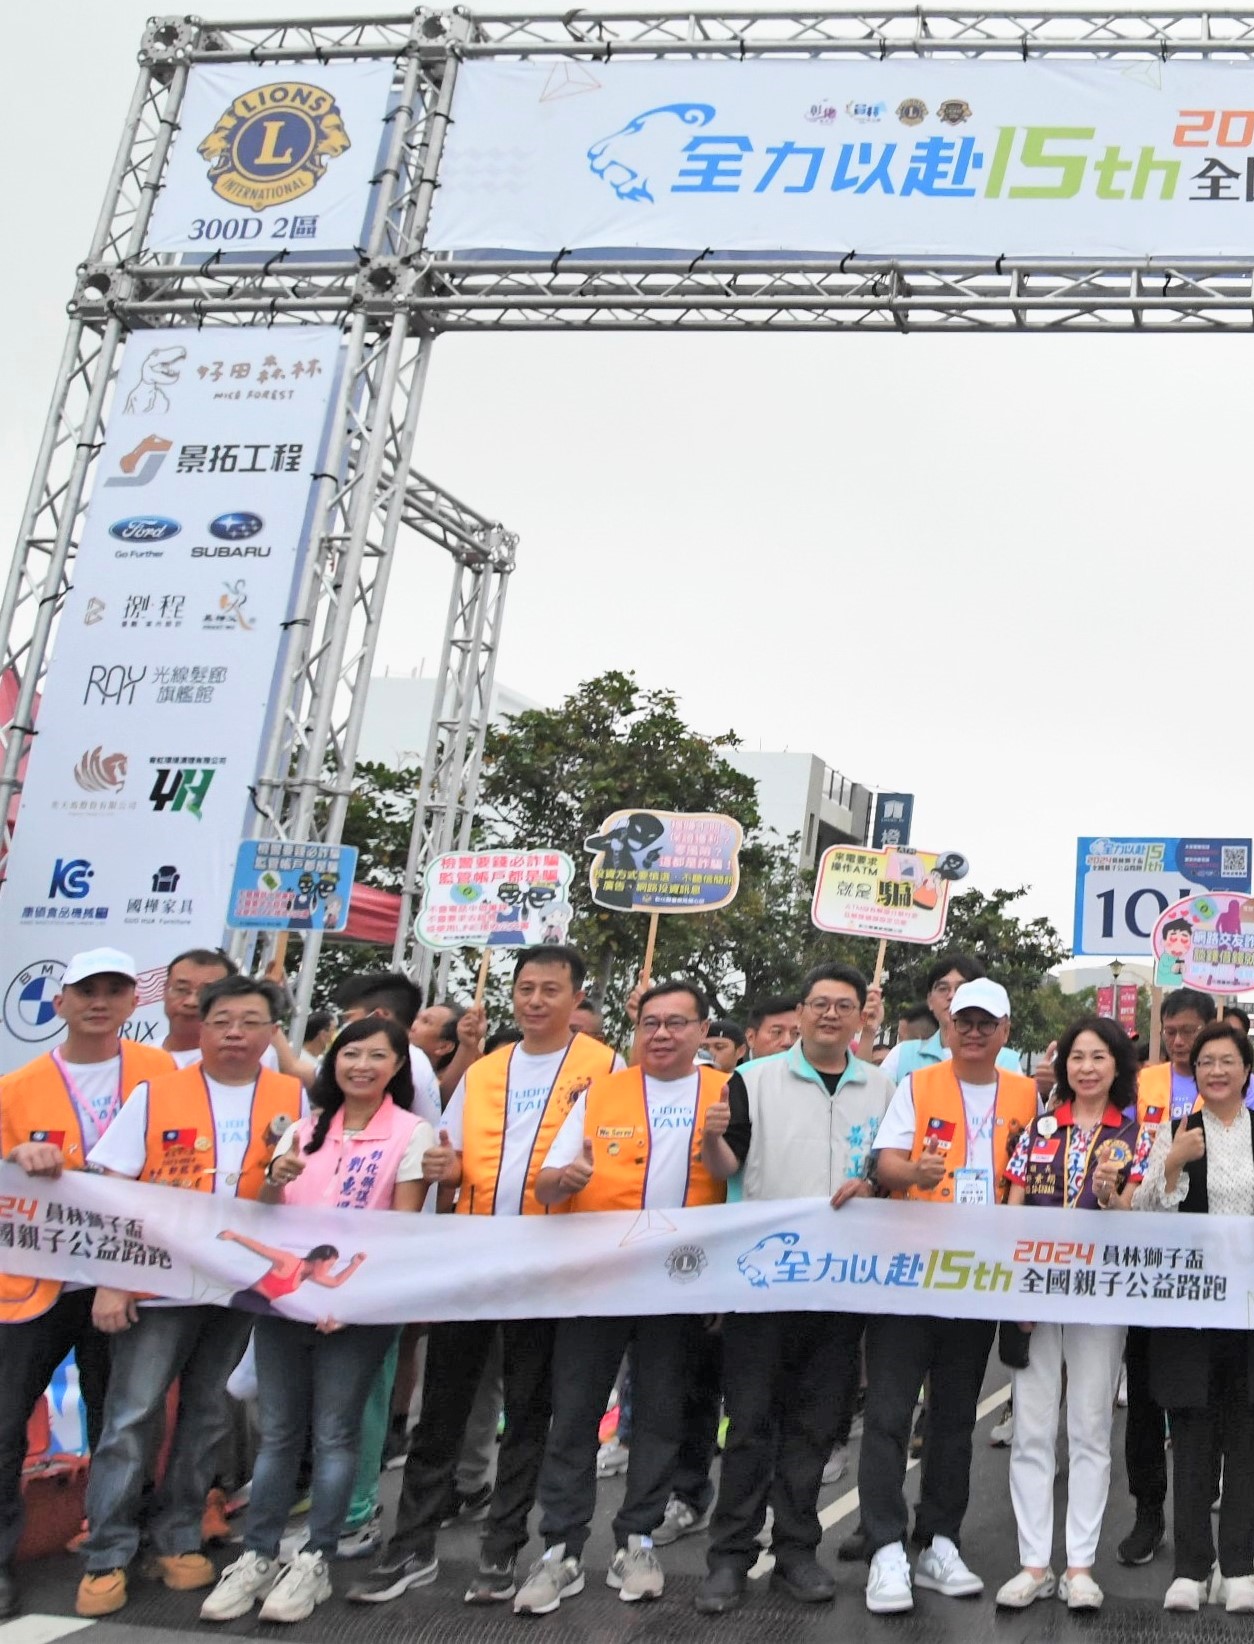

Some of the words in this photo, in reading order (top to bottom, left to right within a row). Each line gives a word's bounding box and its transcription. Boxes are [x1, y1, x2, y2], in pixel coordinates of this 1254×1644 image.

[241, 87, 326, 112] LIONS
[254, 121, 292, 165] L
[671, 135, 983, 198] 全力以赴
[984, 126, 1182, 200] 15th
[223, 177, 308, 200] INTERNATIONAL
[188, 218, 262, 241] 300D
[270, 215, 319, 239] 2區
[246, 389, 294, 400] FOREST
[176, 443, 303, 473] 景拓工程
[121, 518, 165, 538] Ford
[115, 551, 128, 559] Go
[130, 550, 163, 559] Further
[190, 547, 271, 558] SUBARU
[84, 665, 147, 705] RAY
[1096, 888, 1191, 939] 10
[46, 1201, 145, 1240] 員林獅子盃
[1013, 1239, 1096, 1266] 2024
[1102, 1244, 1205, 1270] 員林獅子盃
[771, 1250, 924, 1290] 全力以赴
[923, 1250, 1014, 1293] 15th
[1019, 1268, 1228, 1302] 全國親子公益路跑
